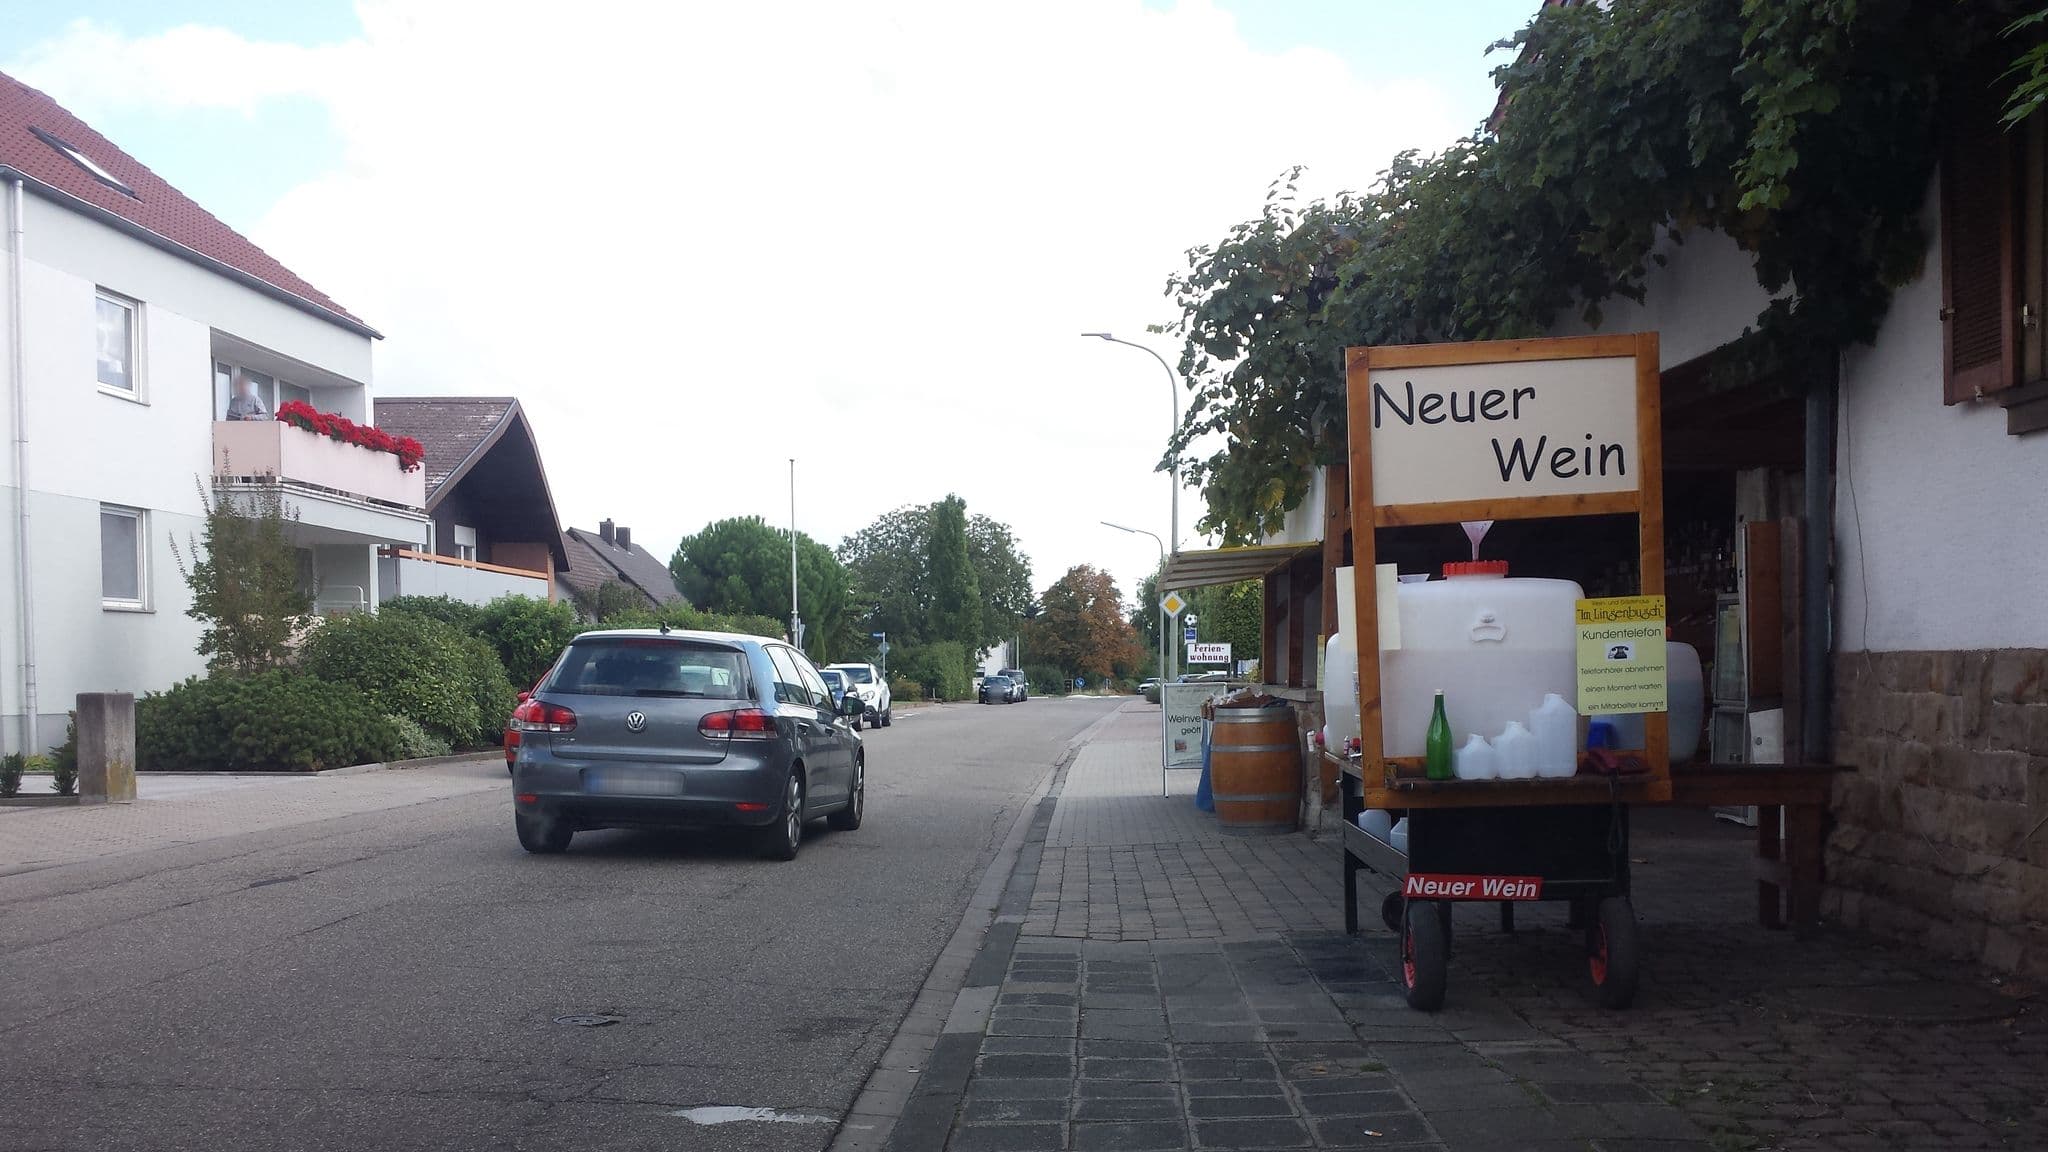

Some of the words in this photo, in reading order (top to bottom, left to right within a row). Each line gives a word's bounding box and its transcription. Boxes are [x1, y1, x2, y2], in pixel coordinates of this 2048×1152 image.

[1373, 381, 1536, 429] Neuer
[1491, 432, 1626, 482] Wein
[1582, 627, 1662, 640] Kundentelefon
[1194, 644, 1225, 653] Ferien-
[1190, 653, 1229, 663] wohnung
[1581, 667, 1623, 675] Telefonhörer
[1625, 665, 1664, 673] abnehmen
[1607, 684, 1637, 692] Moment
[1406, 876, 1475, 896] Neuer
[1482, 878, 1537, 897] Wein
